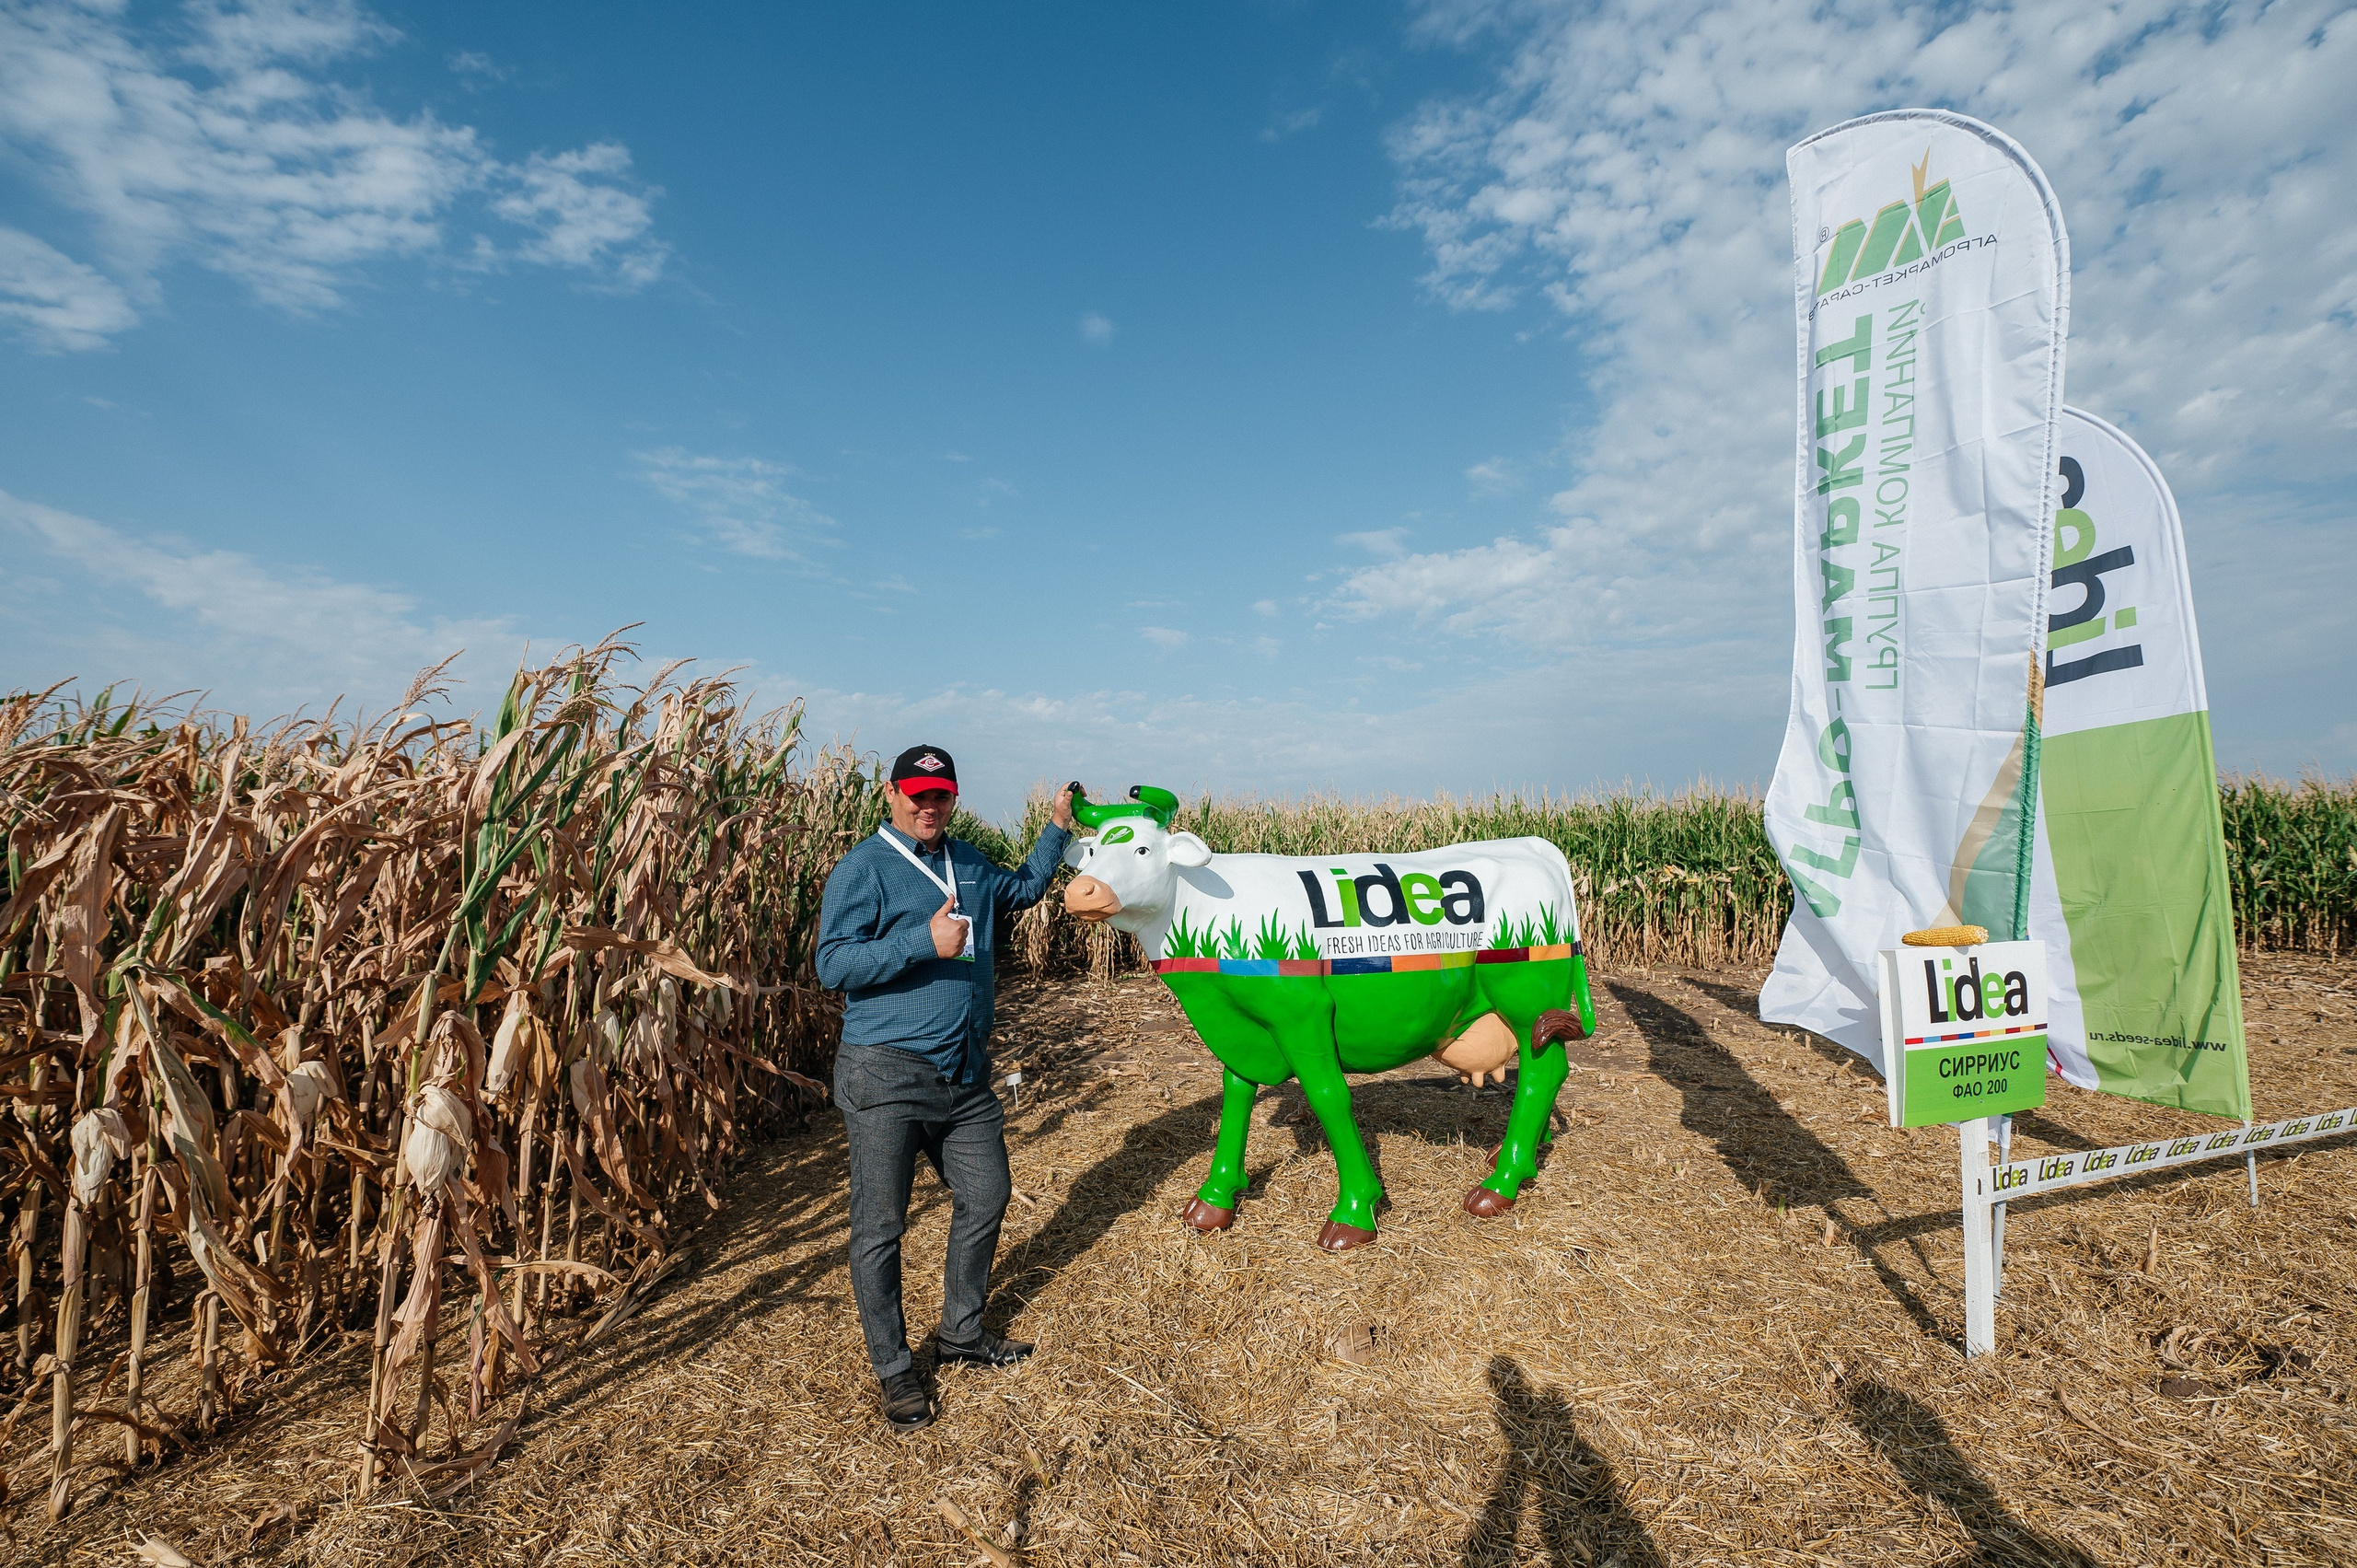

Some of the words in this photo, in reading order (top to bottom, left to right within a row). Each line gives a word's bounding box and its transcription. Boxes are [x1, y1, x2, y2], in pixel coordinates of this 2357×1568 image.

[1296, 864, 1486, 928] Lidea
[1326, 935, 1364, 955] FRESH
[1368, 934, 1402, 953] IDEAS
[1404, 933, 1423, 951] FOR
[1426, 931, 1484, 950] AGRICULTURE
[1923, 957, 2029, 1024] Lidea
[1938, 1051, 2020, 1078] СИРРИУС
[1952, 1081, 1983, 1098] ФАО
[1987, 1078, 2008, 1095] 200
[1993, 1165, 2029, 1191] Lidea
[2038, 1157, 2074, 1181] Lidea
[2082, 1151, 2118, 1173] Lidea
[2124, 1144, 2160, 1165] Lidea
[2165, 1138, 2200, 1157] Lidea
[2204, 1132, 2239, 1151] Lidea
[2243, 1126, 2275, 1144] Lidea
[2279, 1120, 2311, 1137] Lidea
[2314, 1113, 2343, 1132] Lidea
